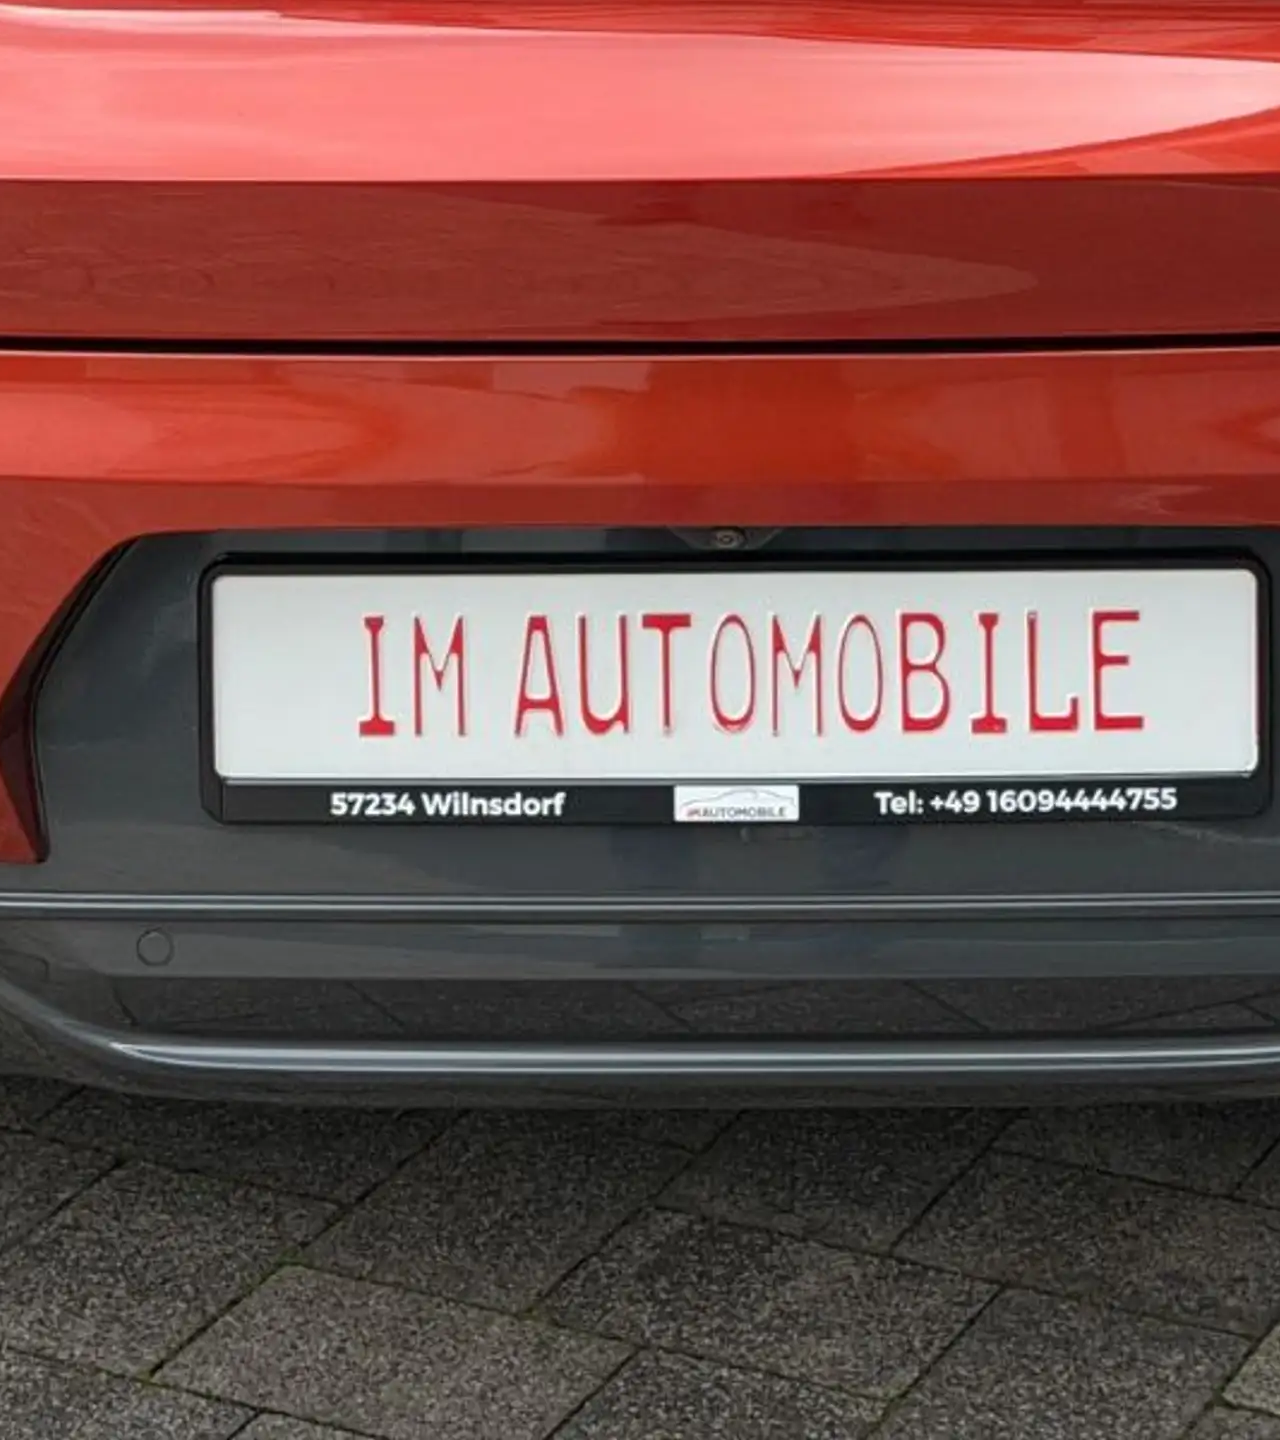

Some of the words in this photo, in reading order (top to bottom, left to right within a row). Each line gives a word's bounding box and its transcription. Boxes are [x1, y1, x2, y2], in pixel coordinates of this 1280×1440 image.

[359, 614, 466, 737] IM
[514, 610, 1144, 737] AUTOMOBILE
[330, 792, 416, 816] 57234
[421, 791, 566, 816] Wilnsdorf
[874, 790, 923, 815] Tel:
[930, 790, 980, 813] +49
[986, 788, 1178, 812] 16094444755
